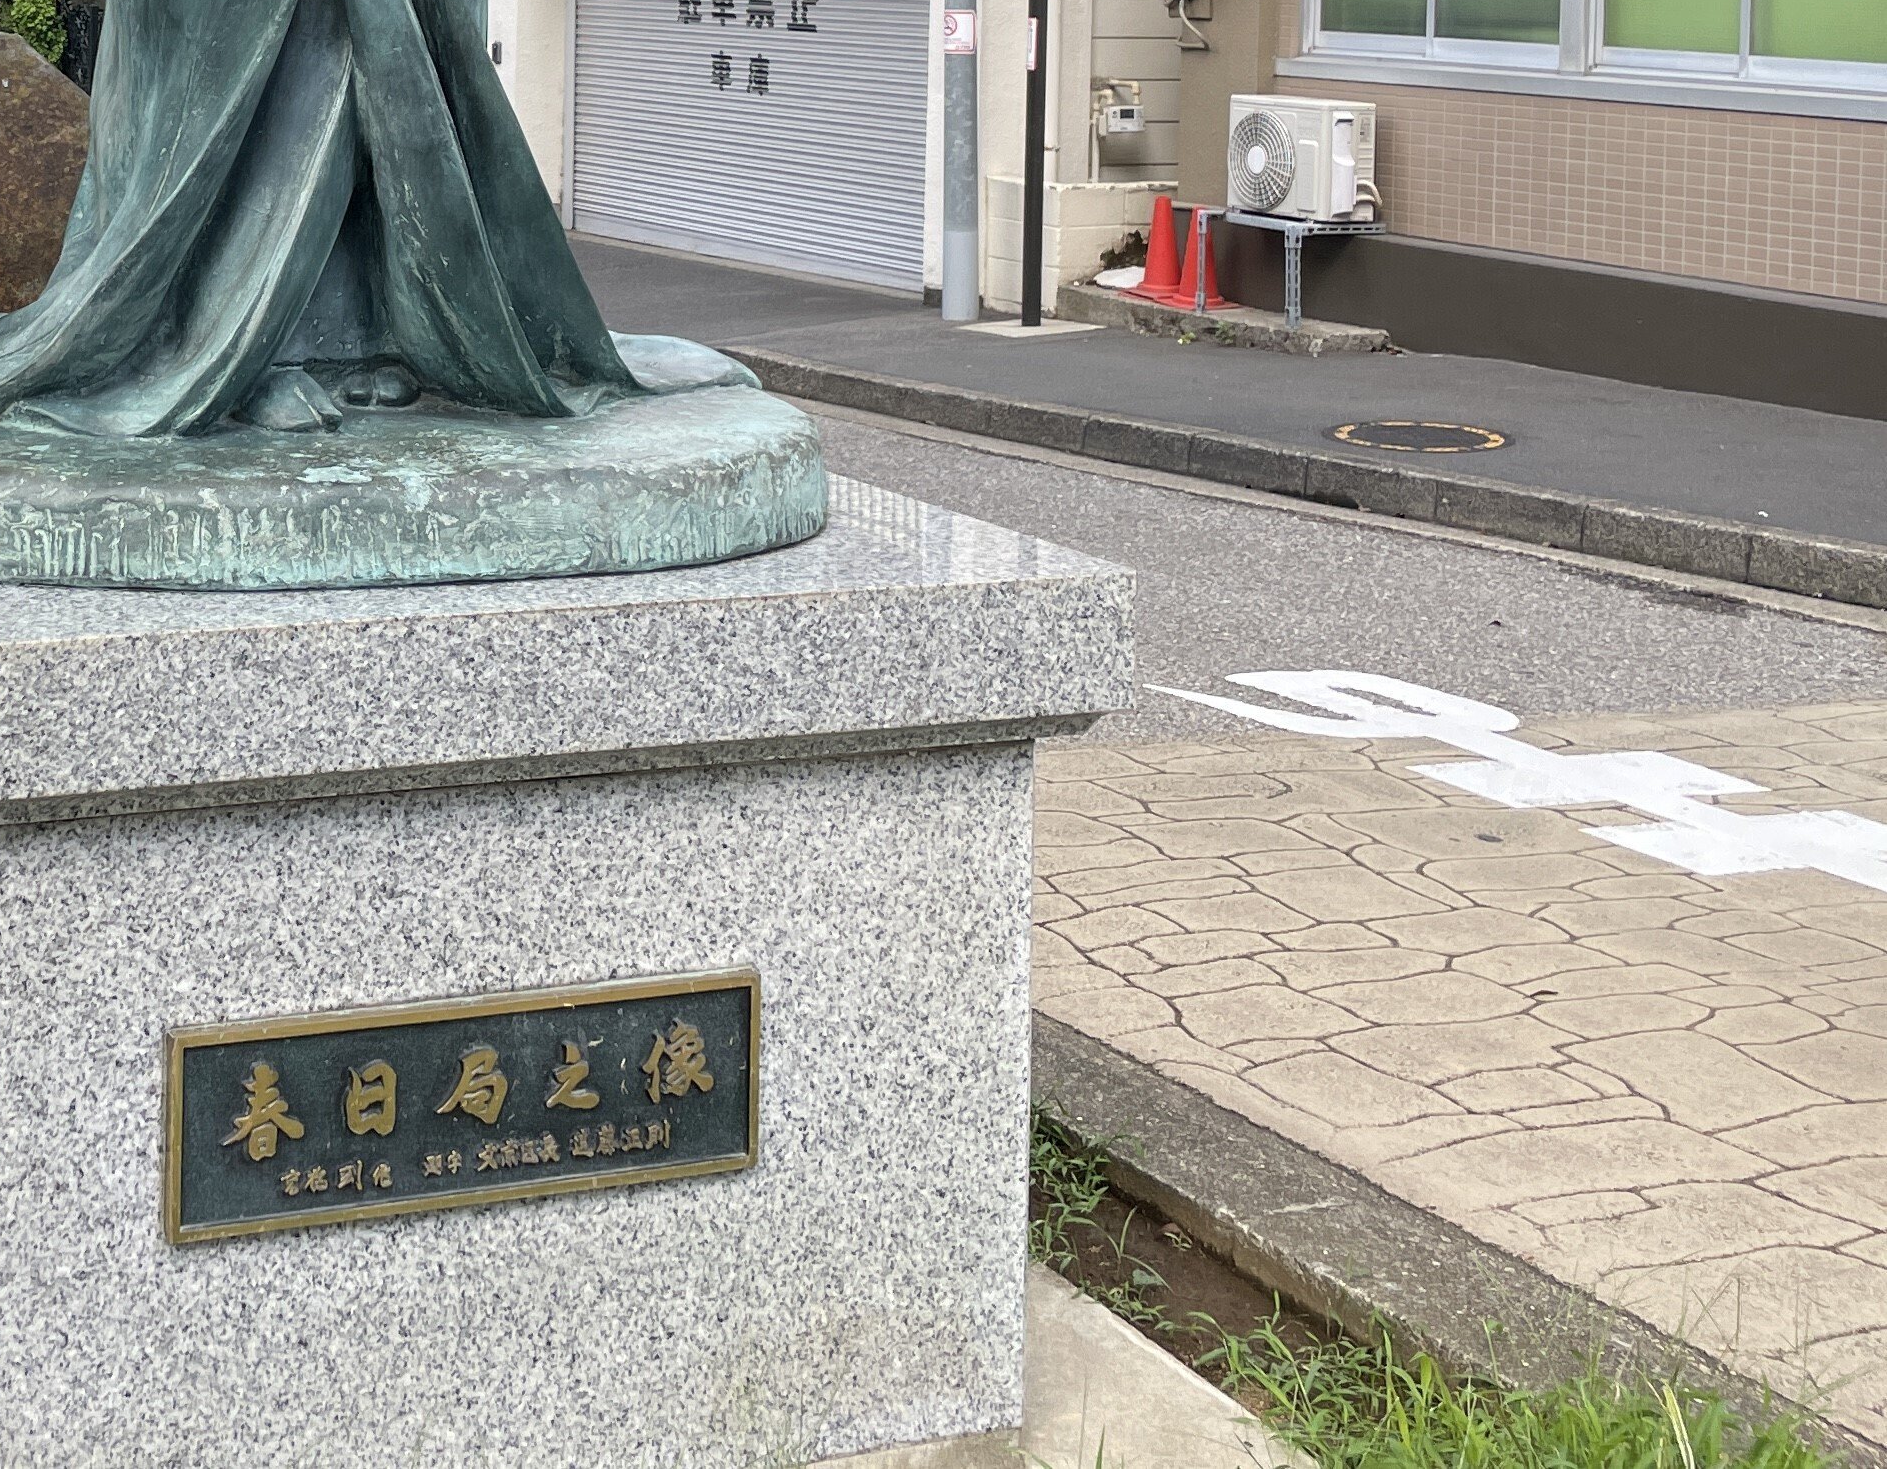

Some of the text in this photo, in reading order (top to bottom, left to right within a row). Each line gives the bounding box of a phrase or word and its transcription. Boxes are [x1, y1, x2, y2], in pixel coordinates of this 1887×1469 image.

[711, 50, 770, 96] 車庫
[222, 1020, 714, 1161] 春日局之像
